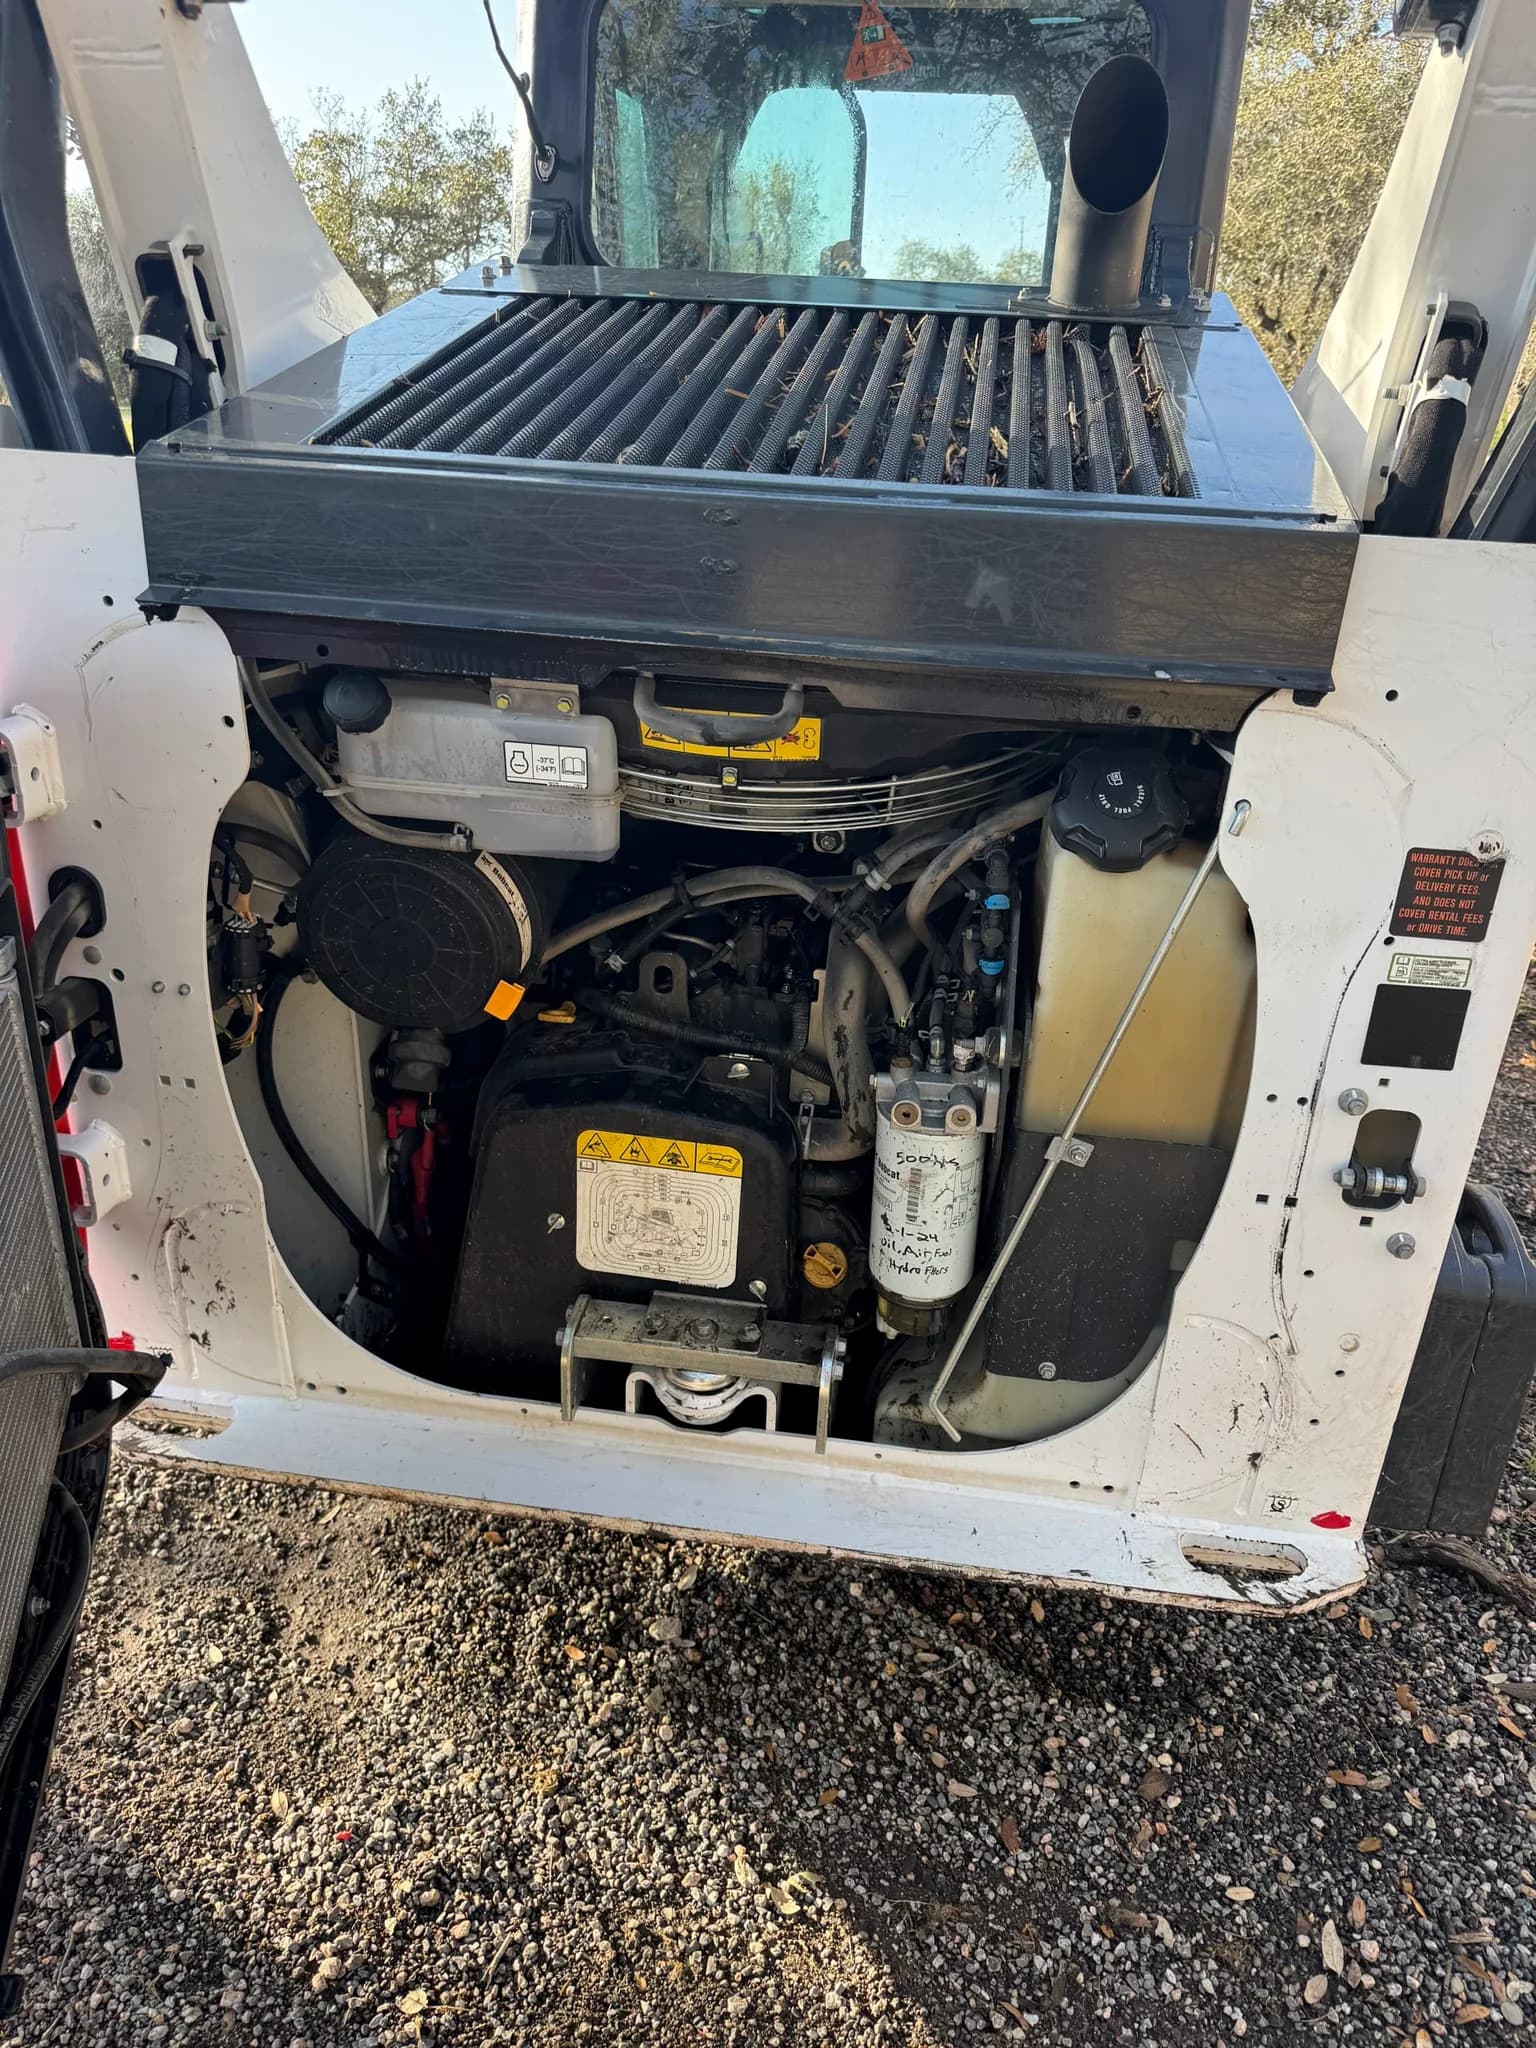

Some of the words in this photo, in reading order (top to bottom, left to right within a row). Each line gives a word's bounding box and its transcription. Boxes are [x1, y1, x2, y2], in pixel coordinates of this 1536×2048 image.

[1098, 794, 1111, 809] ONLY
[1133, 784, 1145, 808] DIESEL
[1114, 806, 1132, 814] FUEL
[1411, 853, 1456, 865] WARRANTY
[492, 866, 515, 897] Bobcat
[1414, 867, 1441, 878] COVER
[1444, 870, 1463, 880] PICK
[1466, 871, 1479, 880] UP
[1480, 874, 1490, 882] or
[1416, 881, 1455, 893] DELIVERY
[1457, 885, 1481, 895] FEES.
[1413, 896, 1431, 905] AND
[1434, 897, 1456, 908] DOES
[1459, 900, 1477, 910] NOT
[1399, 908, 1426, 919] COVER
[1428, 910, 1459, 922] RENTAL
[1462, 913, 1484, 924] FEES
[1407, 924, 1417, 932] or
[1419, 923, 1443, 934] DRIVE
[1446, 926, 1468, 937] TIME.
[889, 1258, 920, 1275] Hydro
